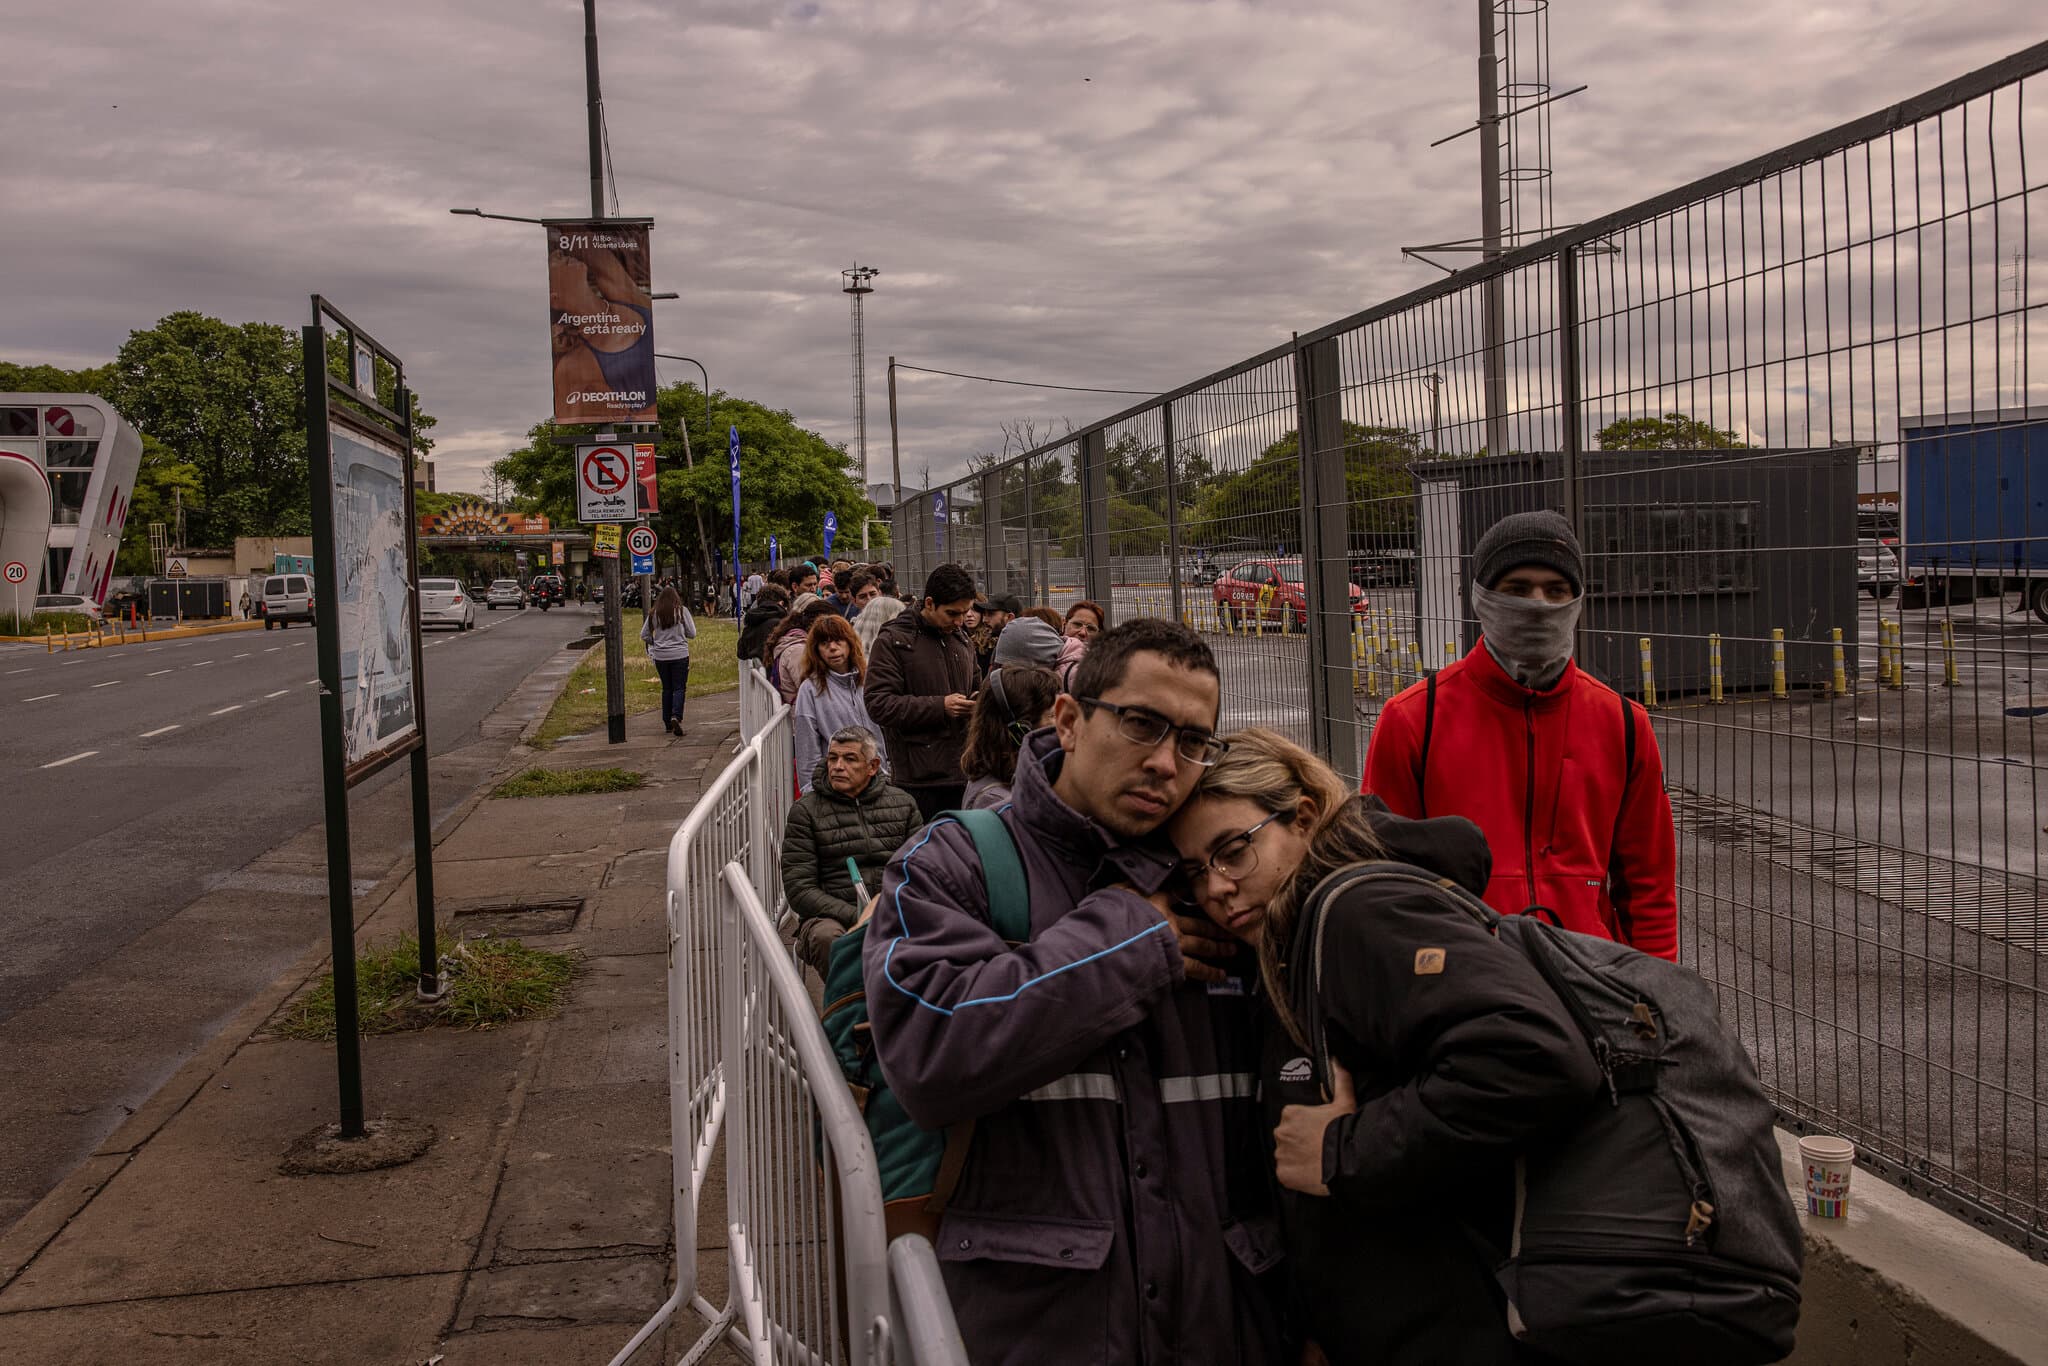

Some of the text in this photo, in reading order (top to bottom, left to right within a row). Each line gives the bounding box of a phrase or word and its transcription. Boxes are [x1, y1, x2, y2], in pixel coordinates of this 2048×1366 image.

[559, 234, 588, 251] 8/11
[618, 241, 638, 250] López
[558, 312, 621, 326] Argentina
[583, 322, 646, 335] está ready
[582, 391, 646, 402] DECATHLON
[633, 535, 652, 549] 60
[9, 568, 22, 577] 20
[1808, 1165, 1841, 1184] feliz
